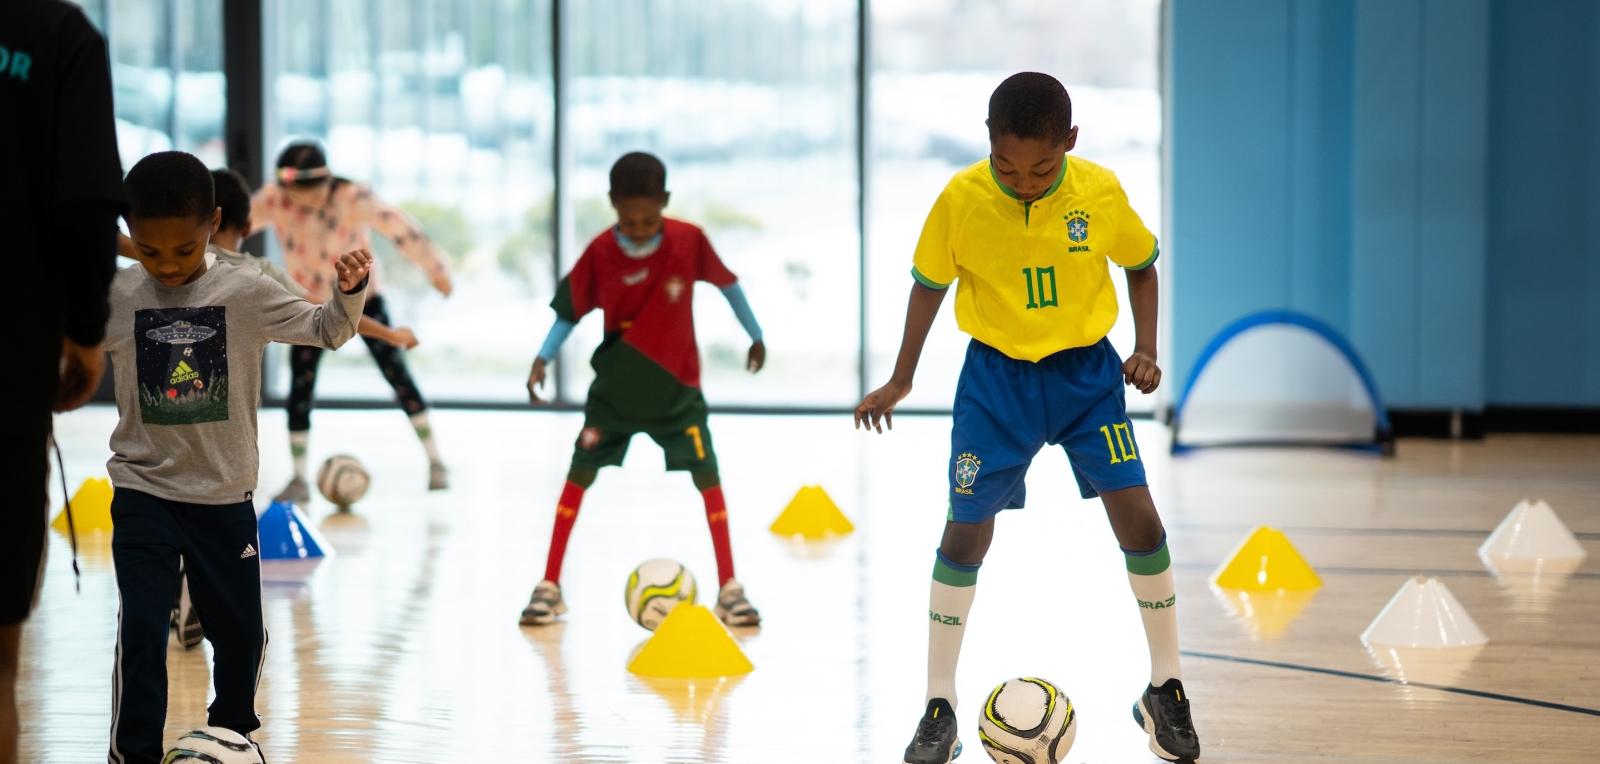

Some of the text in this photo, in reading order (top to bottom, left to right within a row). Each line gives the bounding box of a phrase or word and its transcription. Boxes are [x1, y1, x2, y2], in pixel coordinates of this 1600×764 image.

[1068, 245, 1092, 253] BRASIL
[1022, 265, 1059, 310] 10
[170, 371, 200, 385] adidas
[1099, 422, 1138, 465] 10
[1137, 593, 1176, 610] BRAZ
[928, 610, 963, 626] RAZIL
